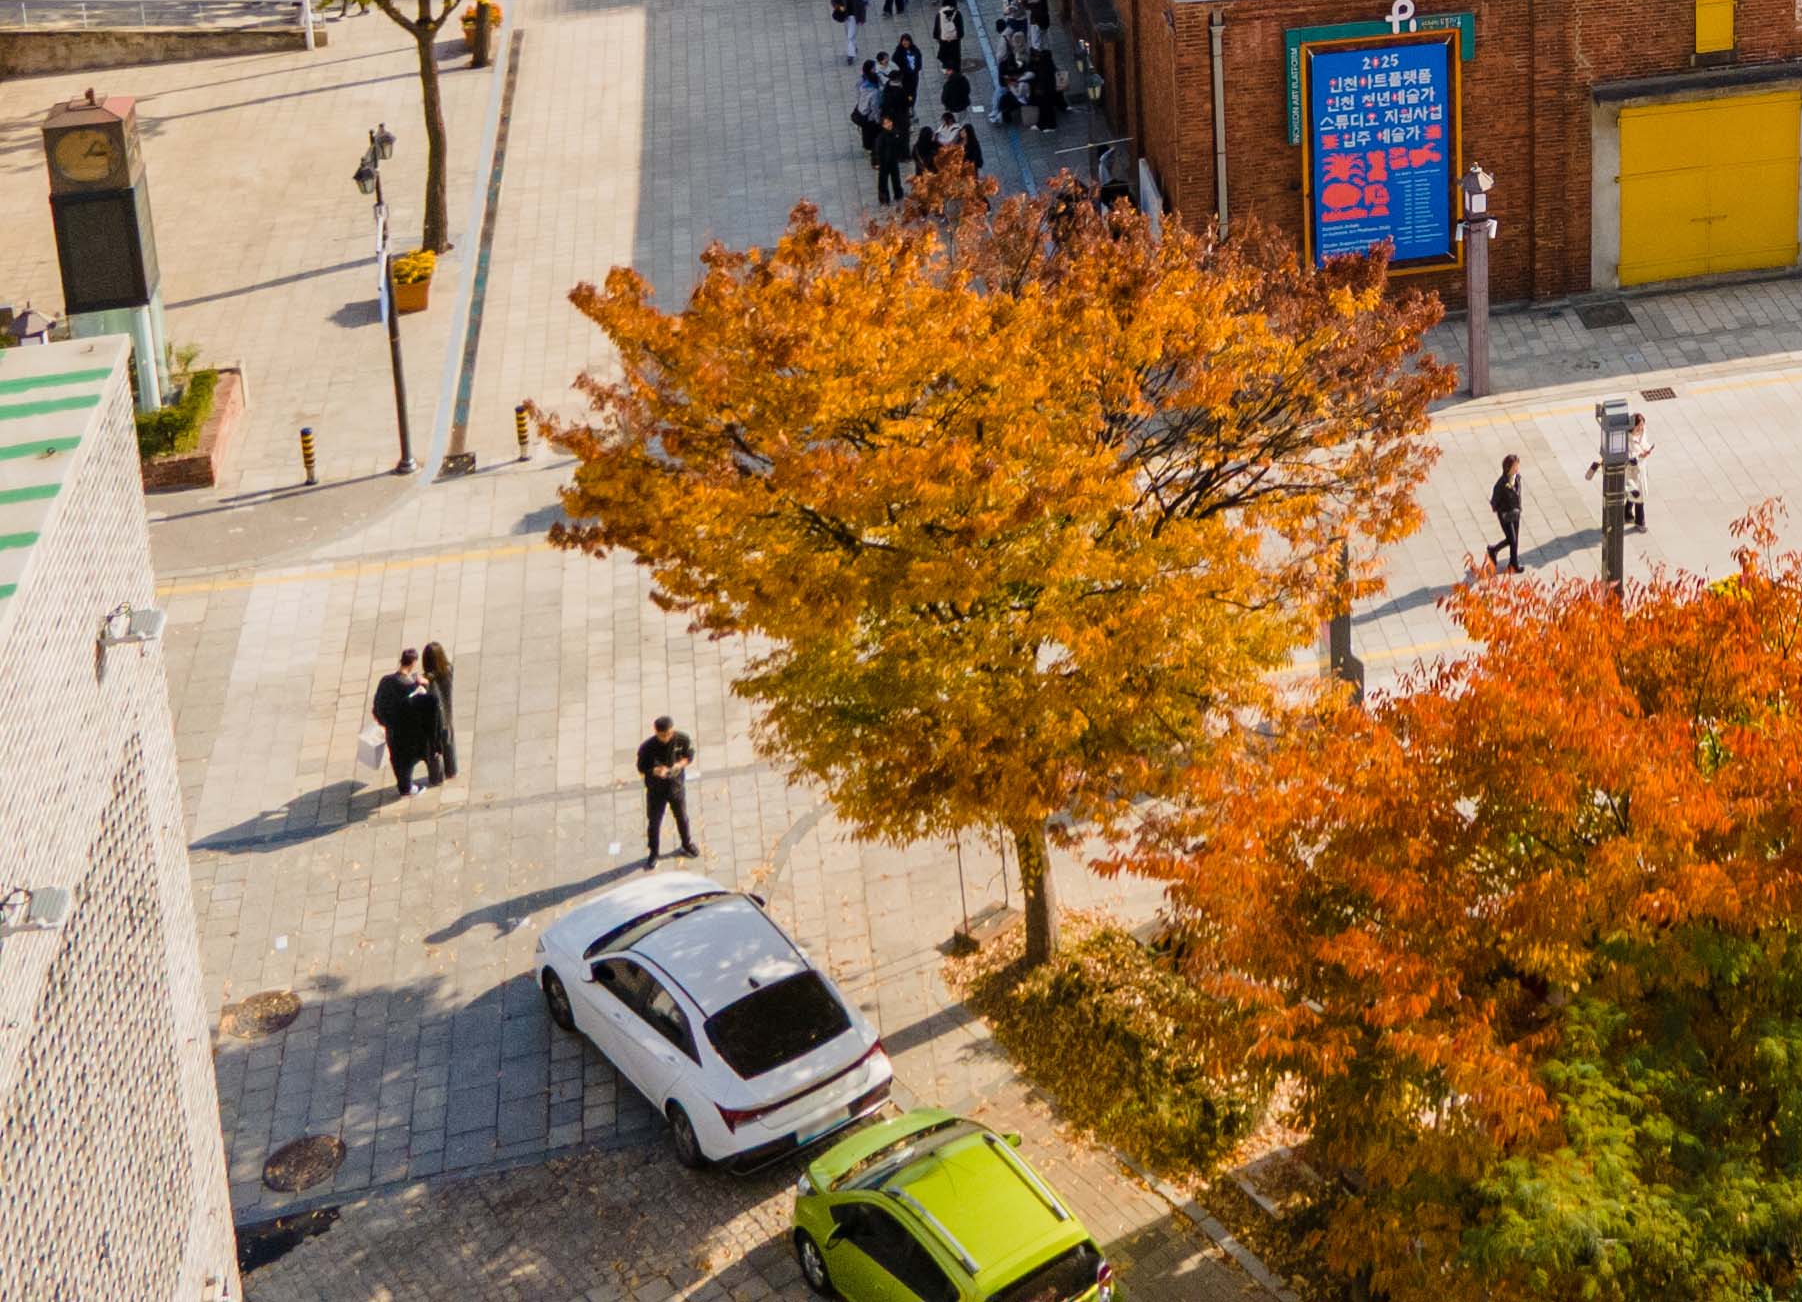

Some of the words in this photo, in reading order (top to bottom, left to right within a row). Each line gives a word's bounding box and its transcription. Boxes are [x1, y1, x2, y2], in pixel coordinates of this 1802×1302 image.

[1329, 68, 1432, 93] 인천아트플랫폼
[1326, 95, 1355, 113] 인천
[1361, 86, 1436, 108] 청년예술가
[1320, 112, 1379, 131] 스튜디오
[1384, 104, 1442, 124] 지원사업
[1343, 129, 1371, 148] 입주
[1376, 125, 1421, 145] 예술가
